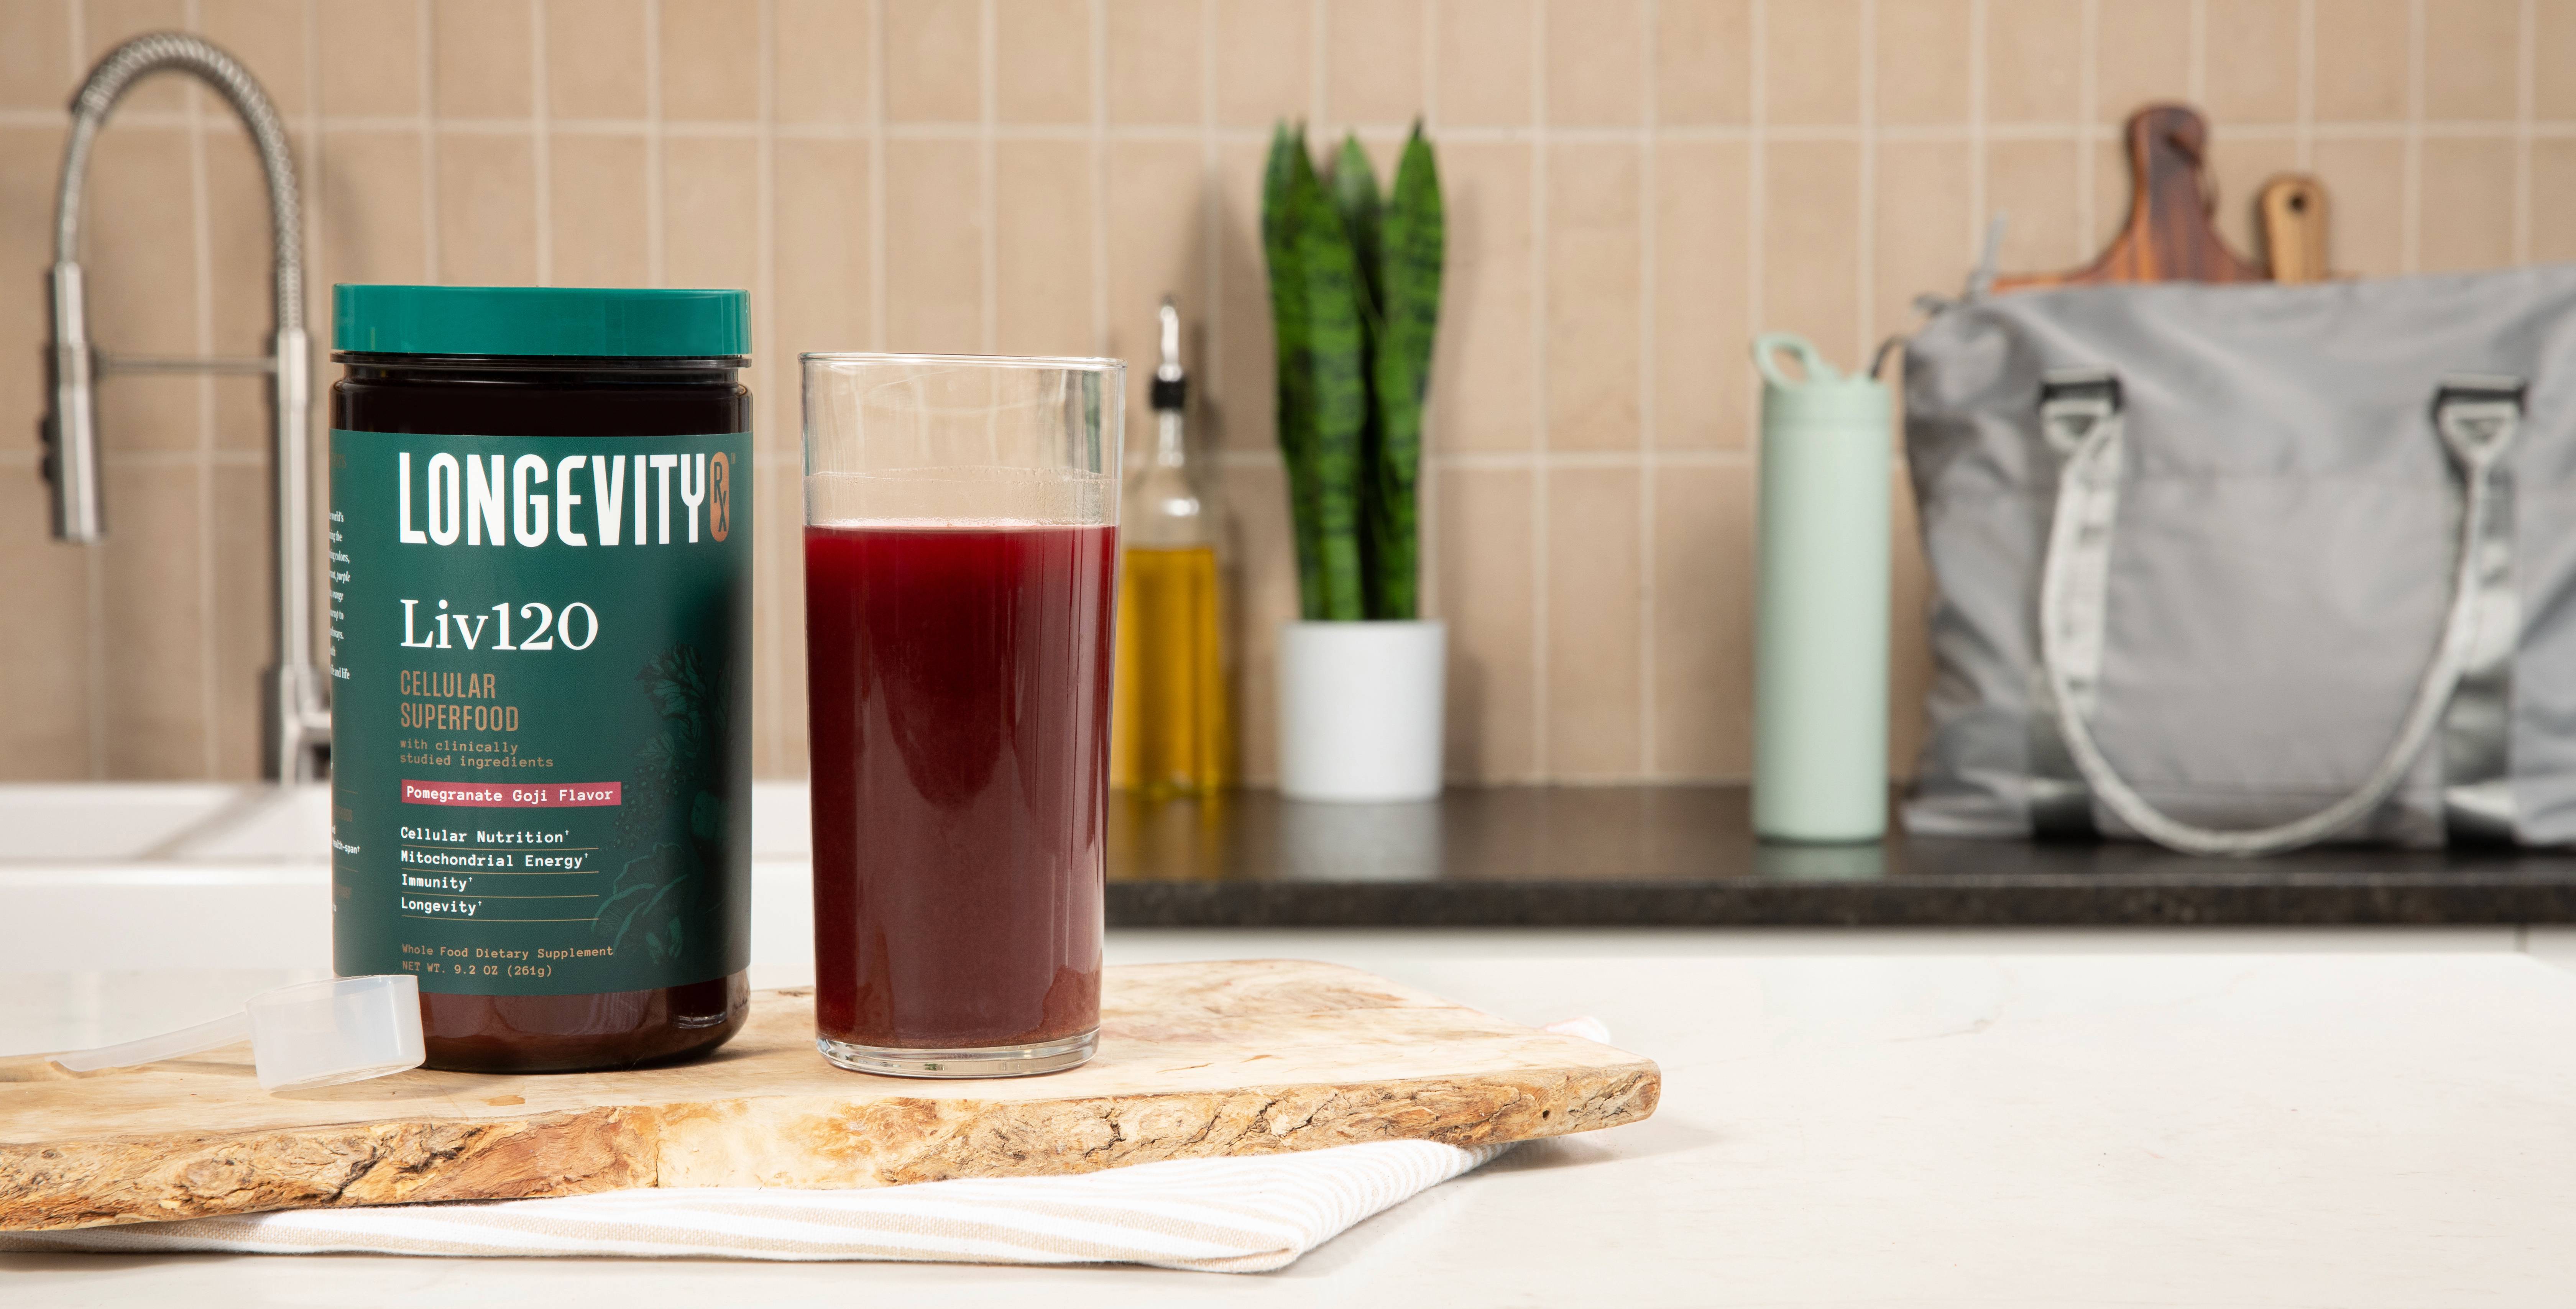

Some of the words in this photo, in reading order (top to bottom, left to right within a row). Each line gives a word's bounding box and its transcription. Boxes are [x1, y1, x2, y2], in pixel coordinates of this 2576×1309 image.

[399, 452, 705, 548] LONGEVITY
[335, 550, 350, 564] colors,
[336, 571, 350, 584] purple
[339, 610, 344, 620] to
[400, 599, 598, 650] Liv120
[342, 668, 350, 679] life
[401, 670, 495, 699] CELLULAR
[401, 702, 518, 731] SUPERFOOD
[400, 738, 427, 750] with
[435, 740, 518, 755] clinically
[400, 753, 451, 766] studied
[460, 755, 553, 769] ingredients
[407, 786, 503, 803] Pomegranate
[513, 789, 547, 805] Goji
[559, 789, 613, 801] Flavor
[401, 826, 467, 842] Cellular
[401, 850, 513, 867] Mitochondrial
[402, 944, 434, 955] Whole
[440, 946, 468, 957] Food
[476, 948, 529, 961] Dietary
[537, 946, 613, 960] Supplement
[402, 961, 421, 971] NET
[427, 963, 445, 973] WT.
[454, 964, 476, 974] 9.2
[483, 965, 498, 975] OZ
[508, 965, 552, 978] (261g)
